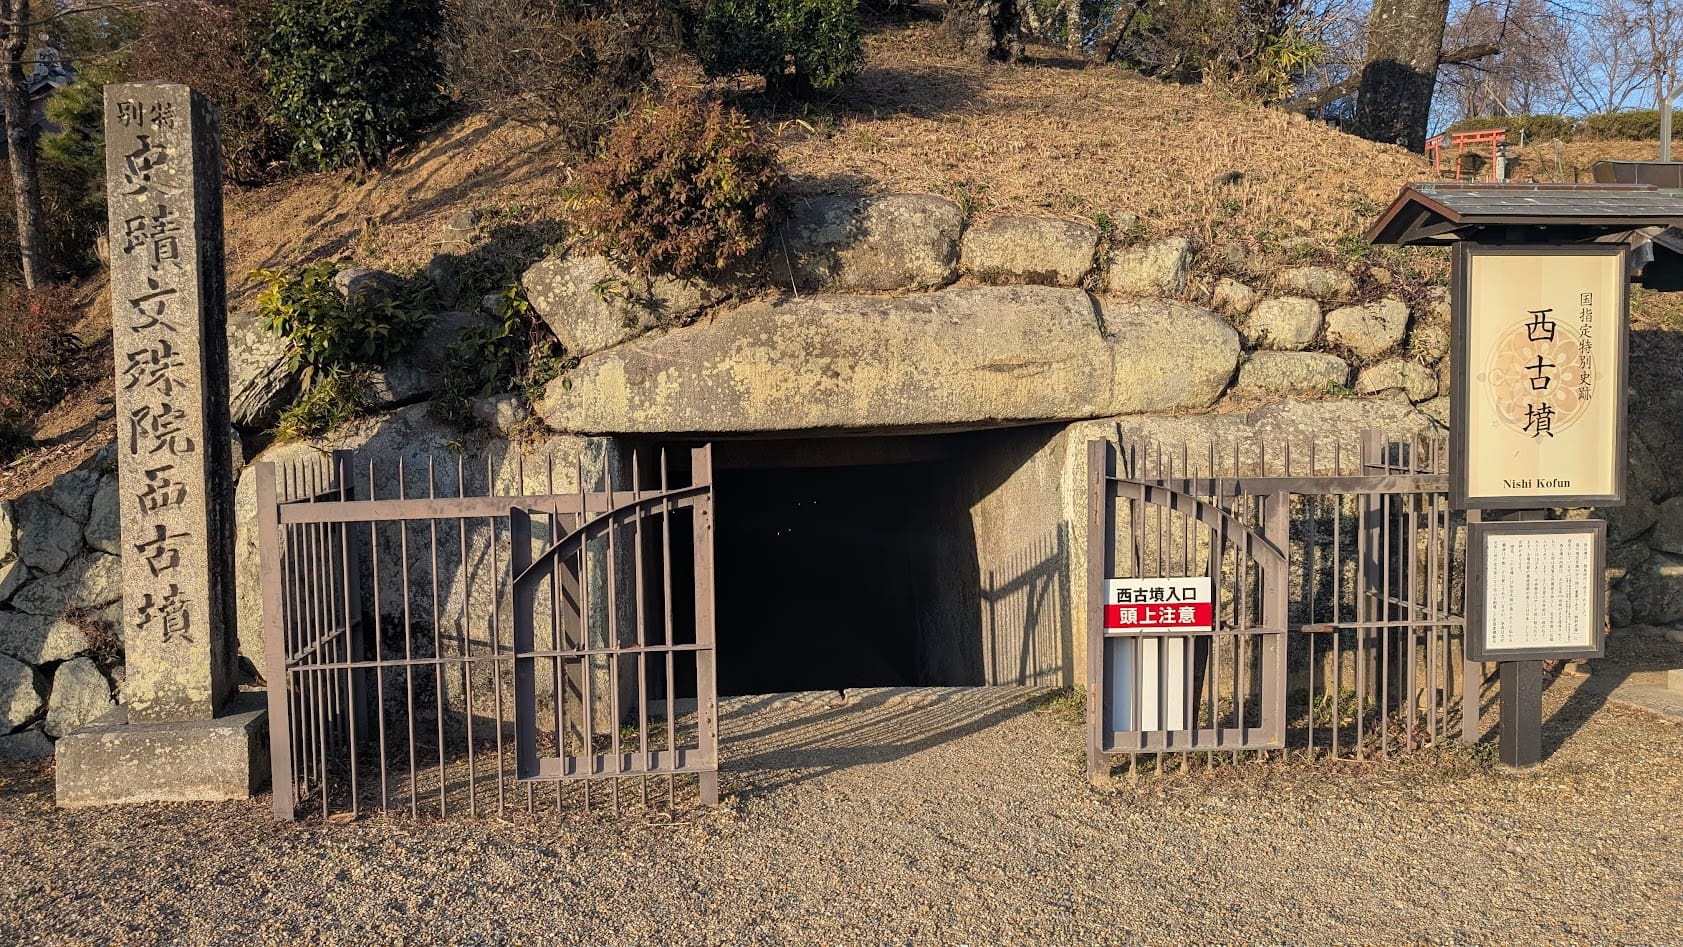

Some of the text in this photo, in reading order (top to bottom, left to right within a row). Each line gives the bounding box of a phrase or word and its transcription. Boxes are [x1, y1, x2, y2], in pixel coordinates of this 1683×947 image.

[1577, 292, 1593, 401] 国指定特別史跡
[1522, 308, 1557, 439] 西古墳
[1503, 478, 1571, 489] Nishi Kofun
[1116, 586, 1197, 604] 西古墳入口
[1119, 606, 1196, 625] 頭上注意
